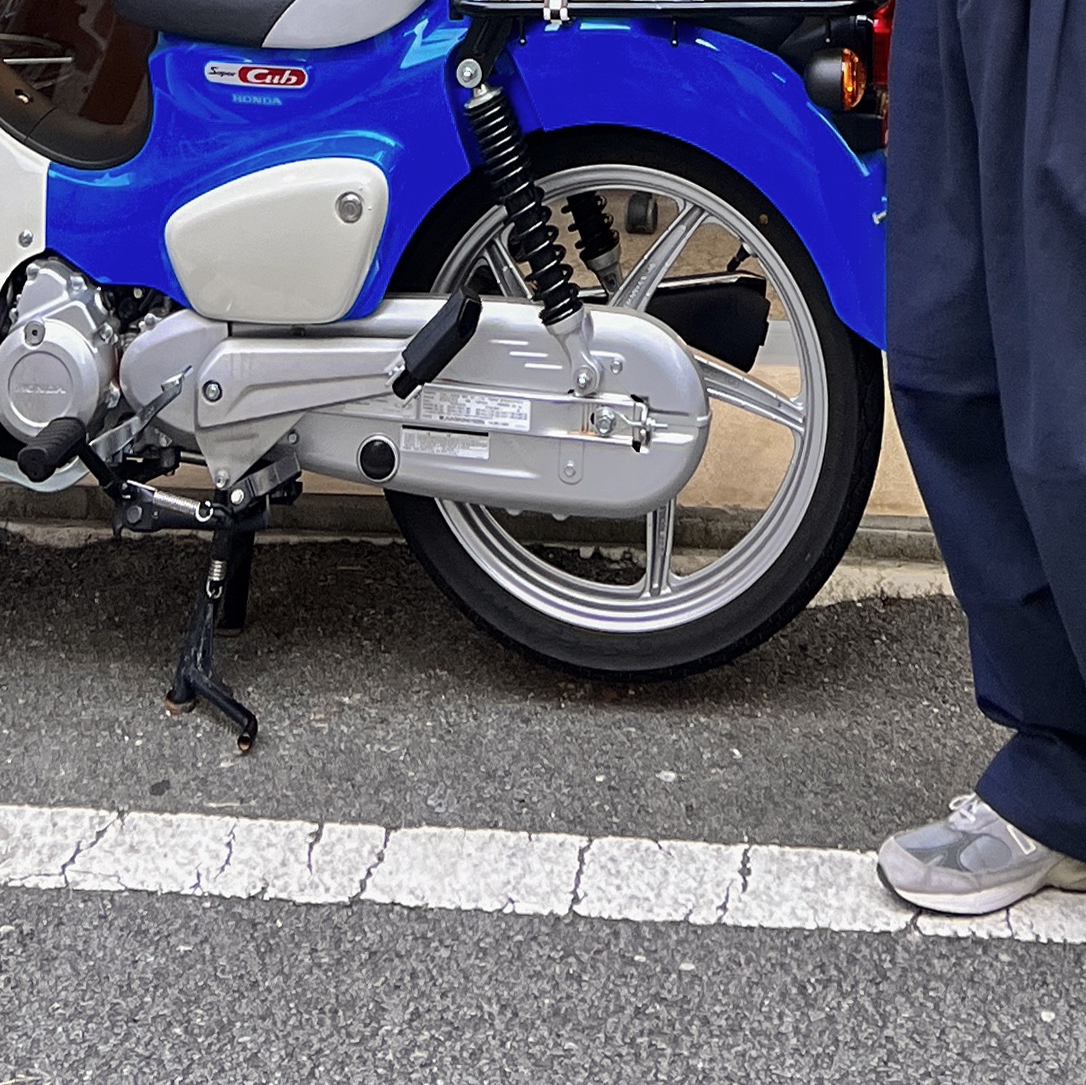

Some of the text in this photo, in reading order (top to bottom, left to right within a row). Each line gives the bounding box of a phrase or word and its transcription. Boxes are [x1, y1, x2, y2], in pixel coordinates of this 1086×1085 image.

[208, 66, 298, 85] Super Cub
[232, 93, 283, 106] HONDA
